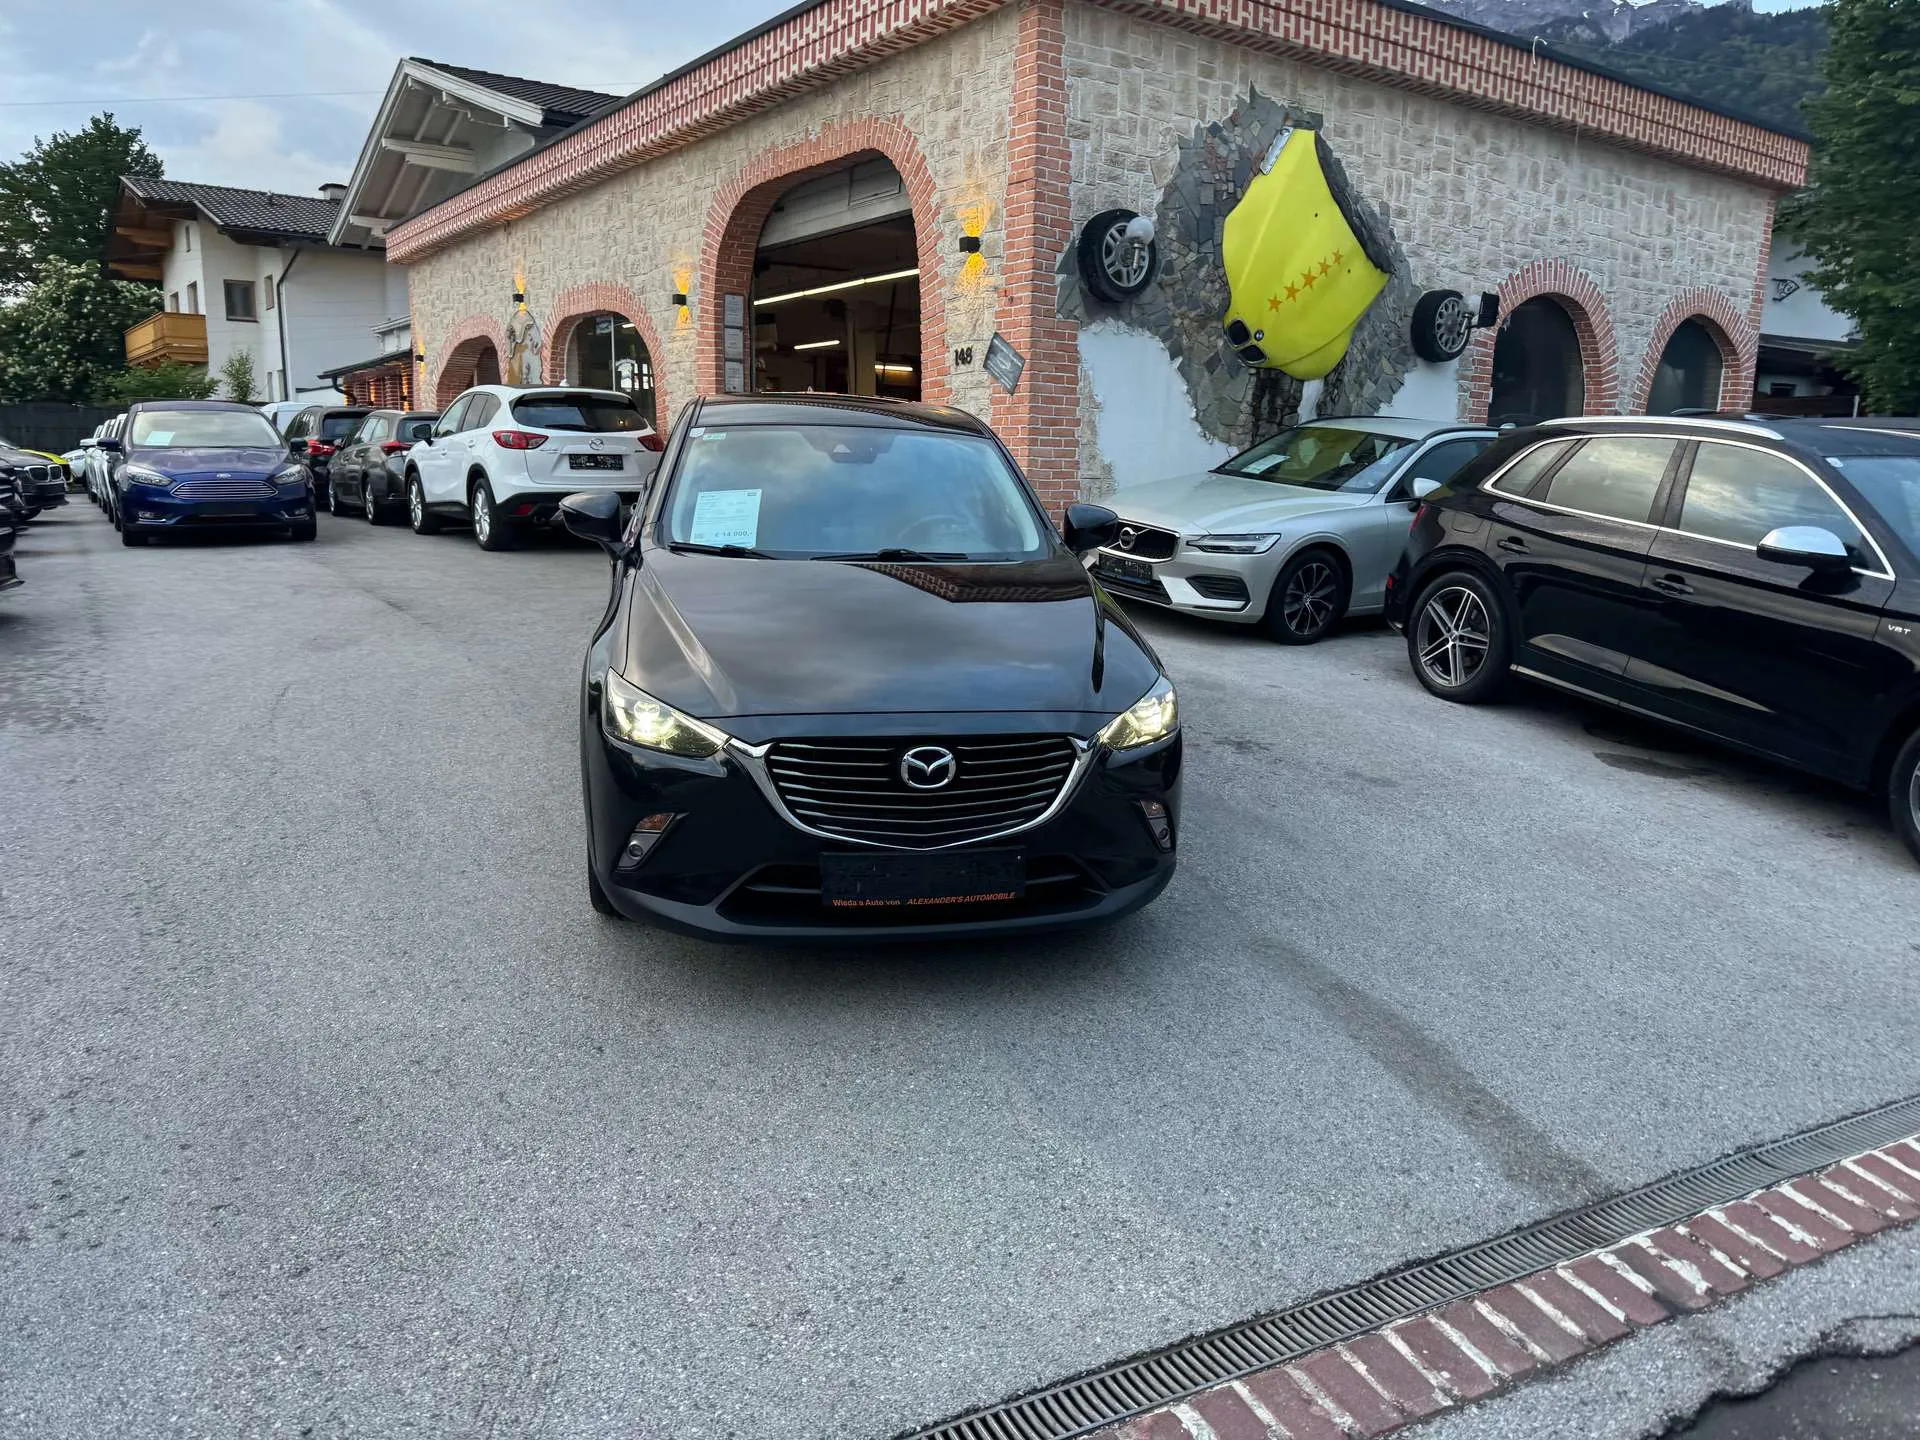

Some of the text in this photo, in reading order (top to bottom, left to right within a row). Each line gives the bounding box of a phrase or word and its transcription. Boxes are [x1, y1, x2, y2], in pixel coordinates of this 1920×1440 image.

[954, 347, 973, 366] 148
[907, 895, 964, 905] ALEXANDER'S
[964, 891, 1017, 903] AUTOMOBILE
